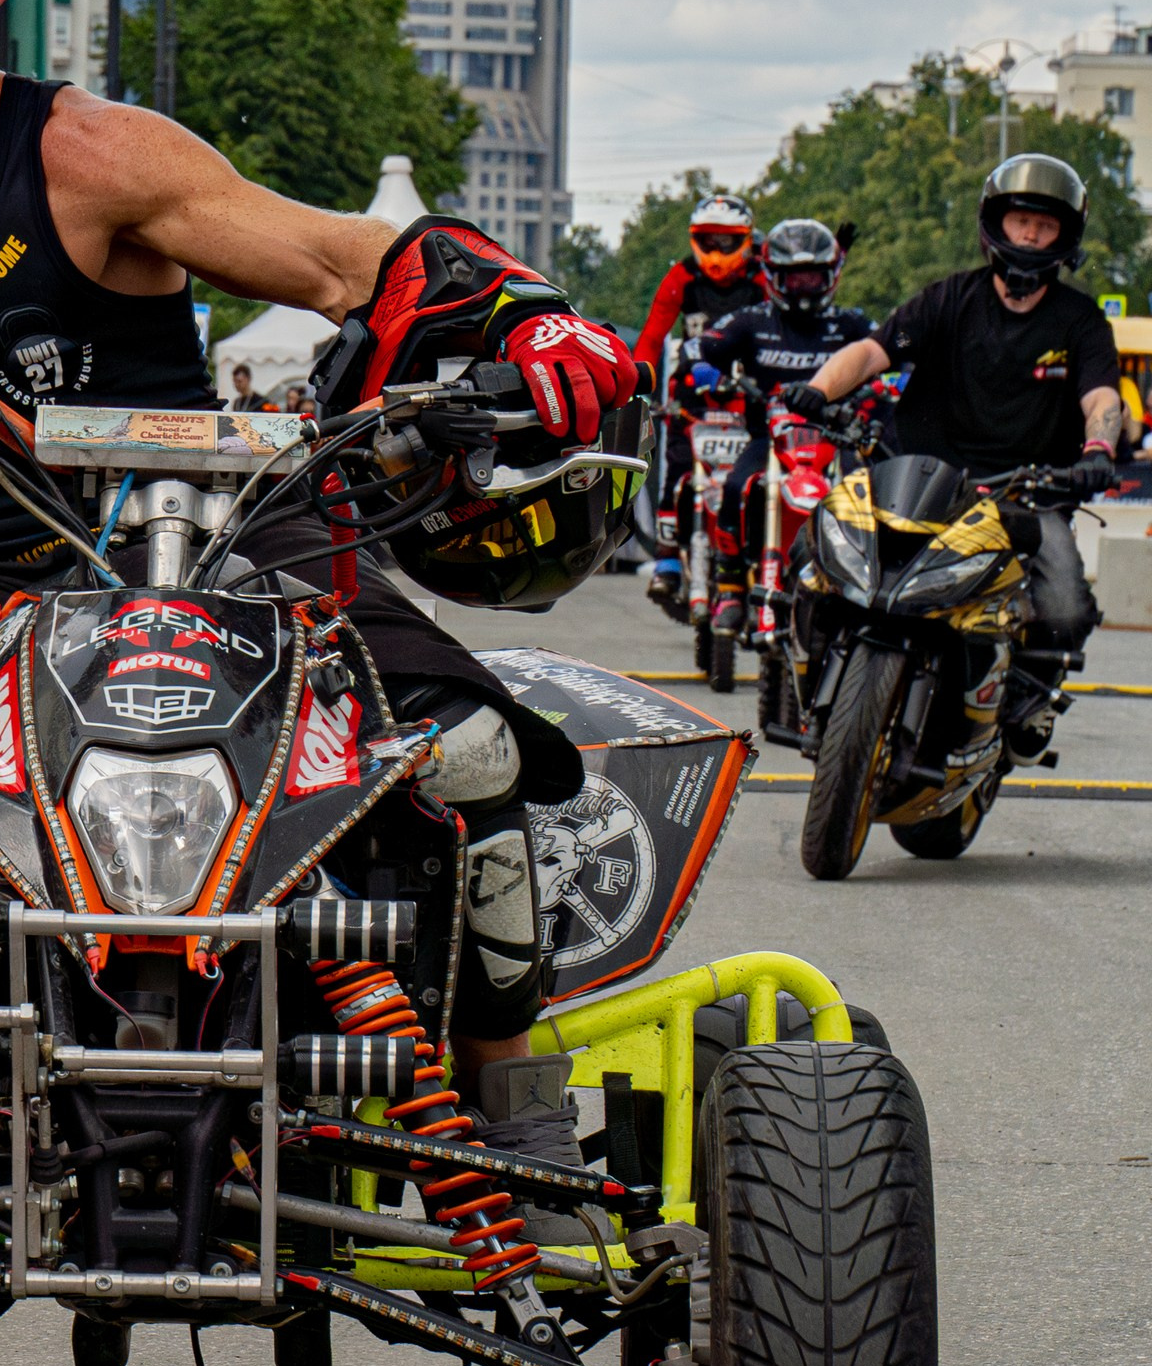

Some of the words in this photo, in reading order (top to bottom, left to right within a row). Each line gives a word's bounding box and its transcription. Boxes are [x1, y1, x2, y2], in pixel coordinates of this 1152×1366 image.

[15, 338, 59, 366] UNIT
[73, 343, 93, 391] PHUKET
[25, 355, 63, 393] 27
[142, 415, 206, 423] PEANUTS
[421, 511, 453, 534] HEAD
[61, 605, 264, 659] LEGEND
[95, 624, 167, 650] STUNT
[173, 627, 229, 654] TEAM
[113, 653, 207, 677] MOTUL
[664, 766, 689, 820] @KAWABANDA
[594, 856, 632, 895] F
